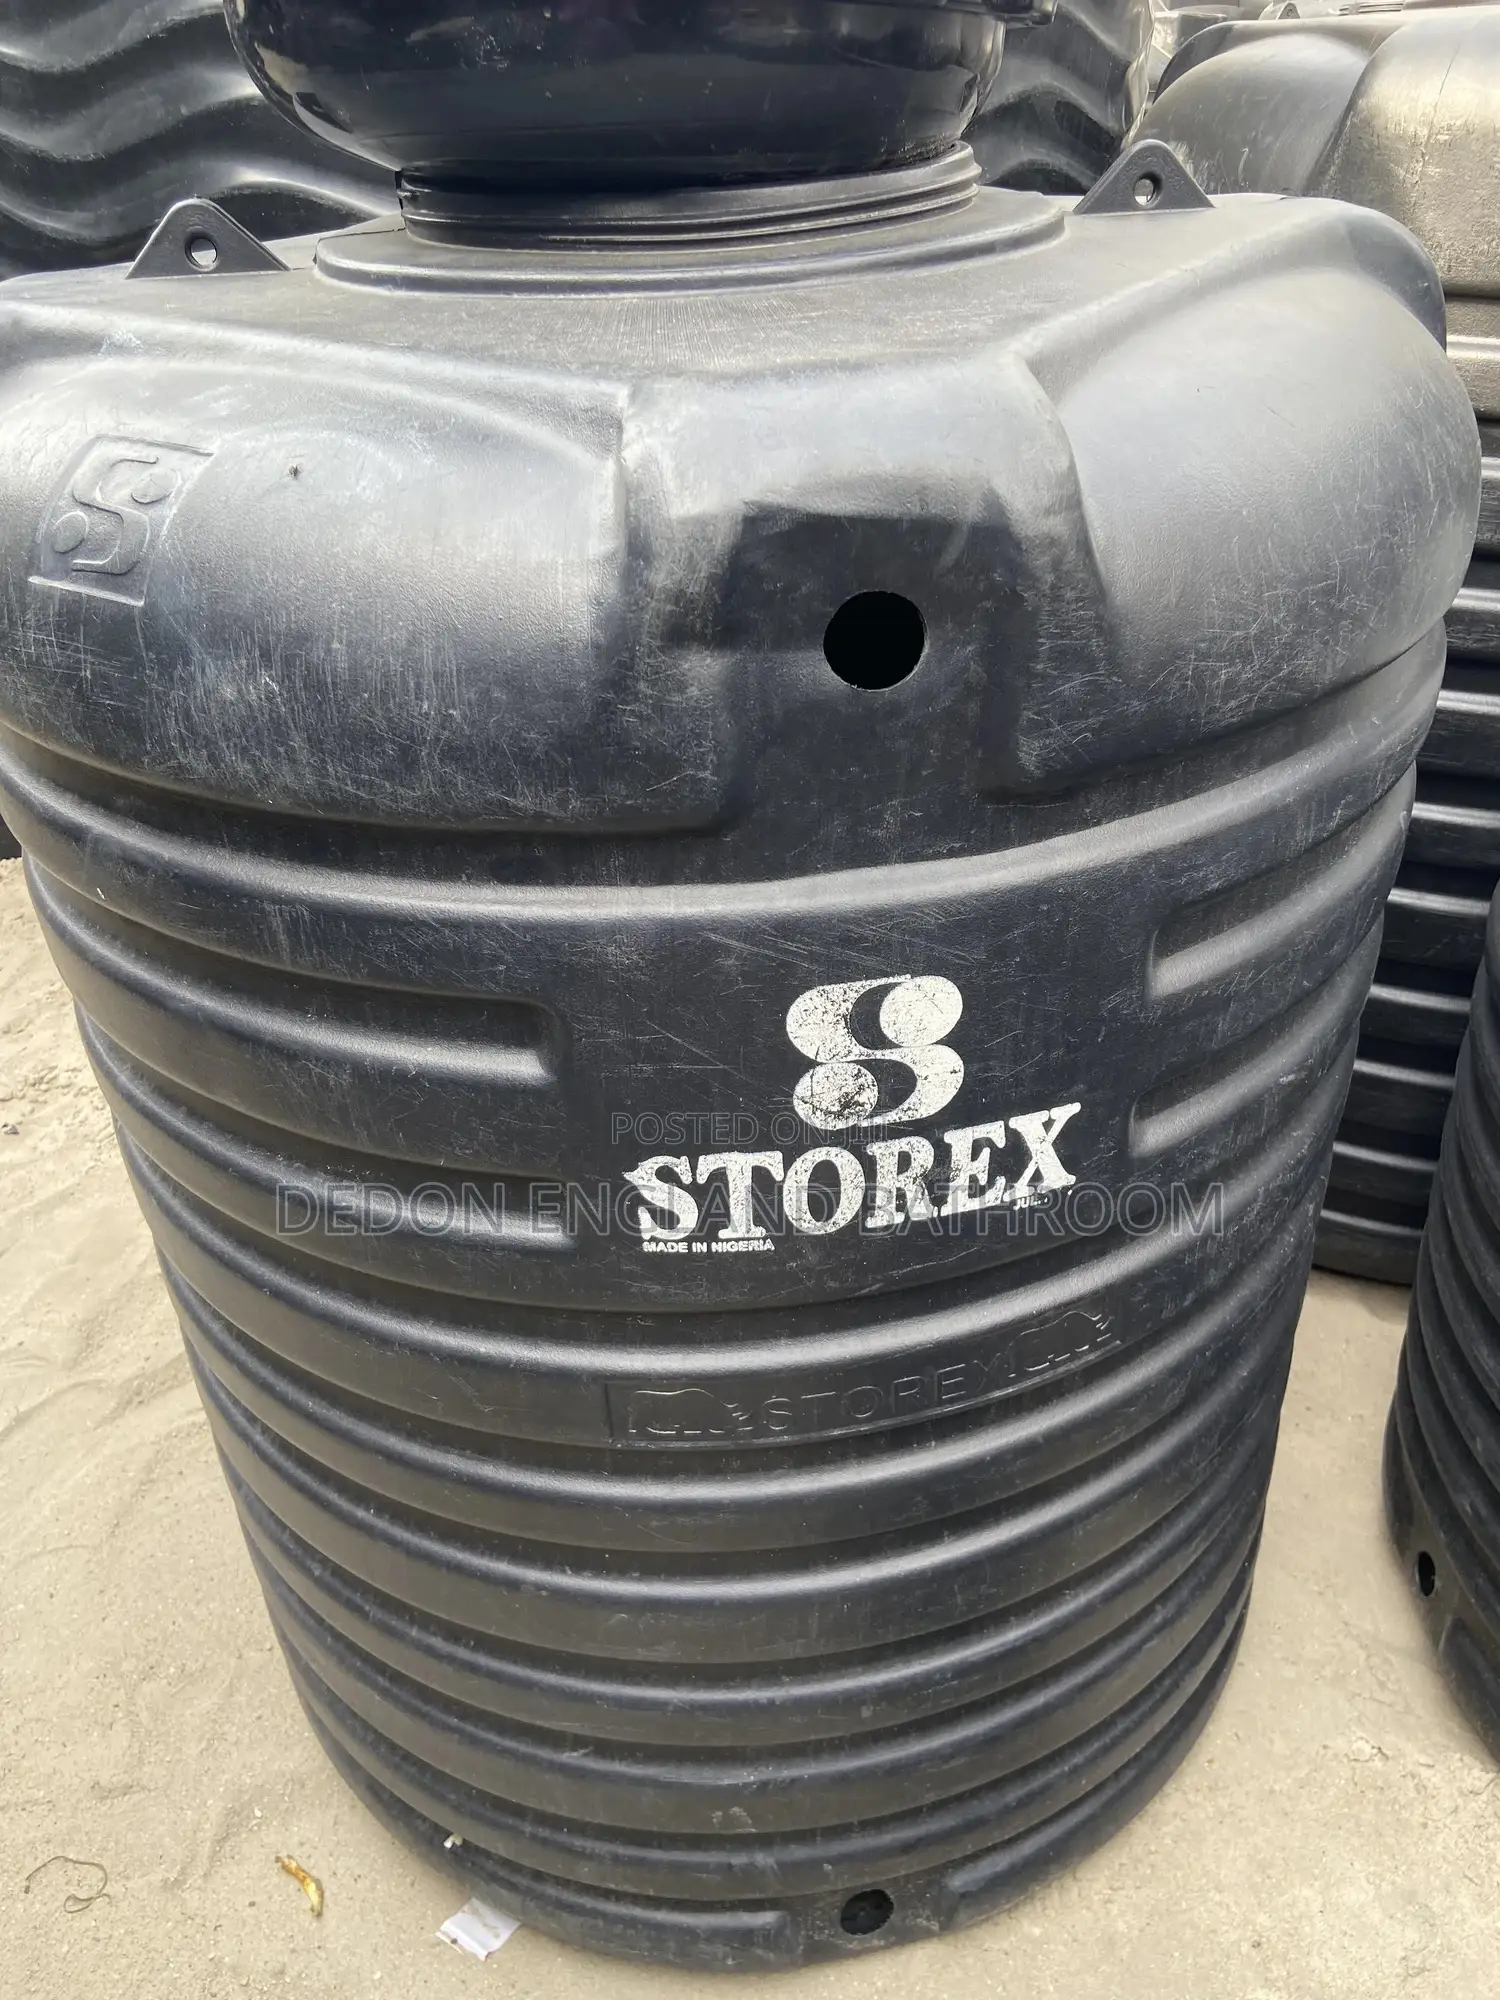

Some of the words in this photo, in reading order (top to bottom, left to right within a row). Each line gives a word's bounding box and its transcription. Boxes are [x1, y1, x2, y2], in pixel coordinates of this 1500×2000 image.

[623, 1102, 1082, 1241] STOREX
[642, 1241, 689, 1253] MADE
[691, 1241, 708, 1253] IN
[711, 1238, 776, 1253] NIGERIA
[763, 1351, 1002, 1430] STOREX
